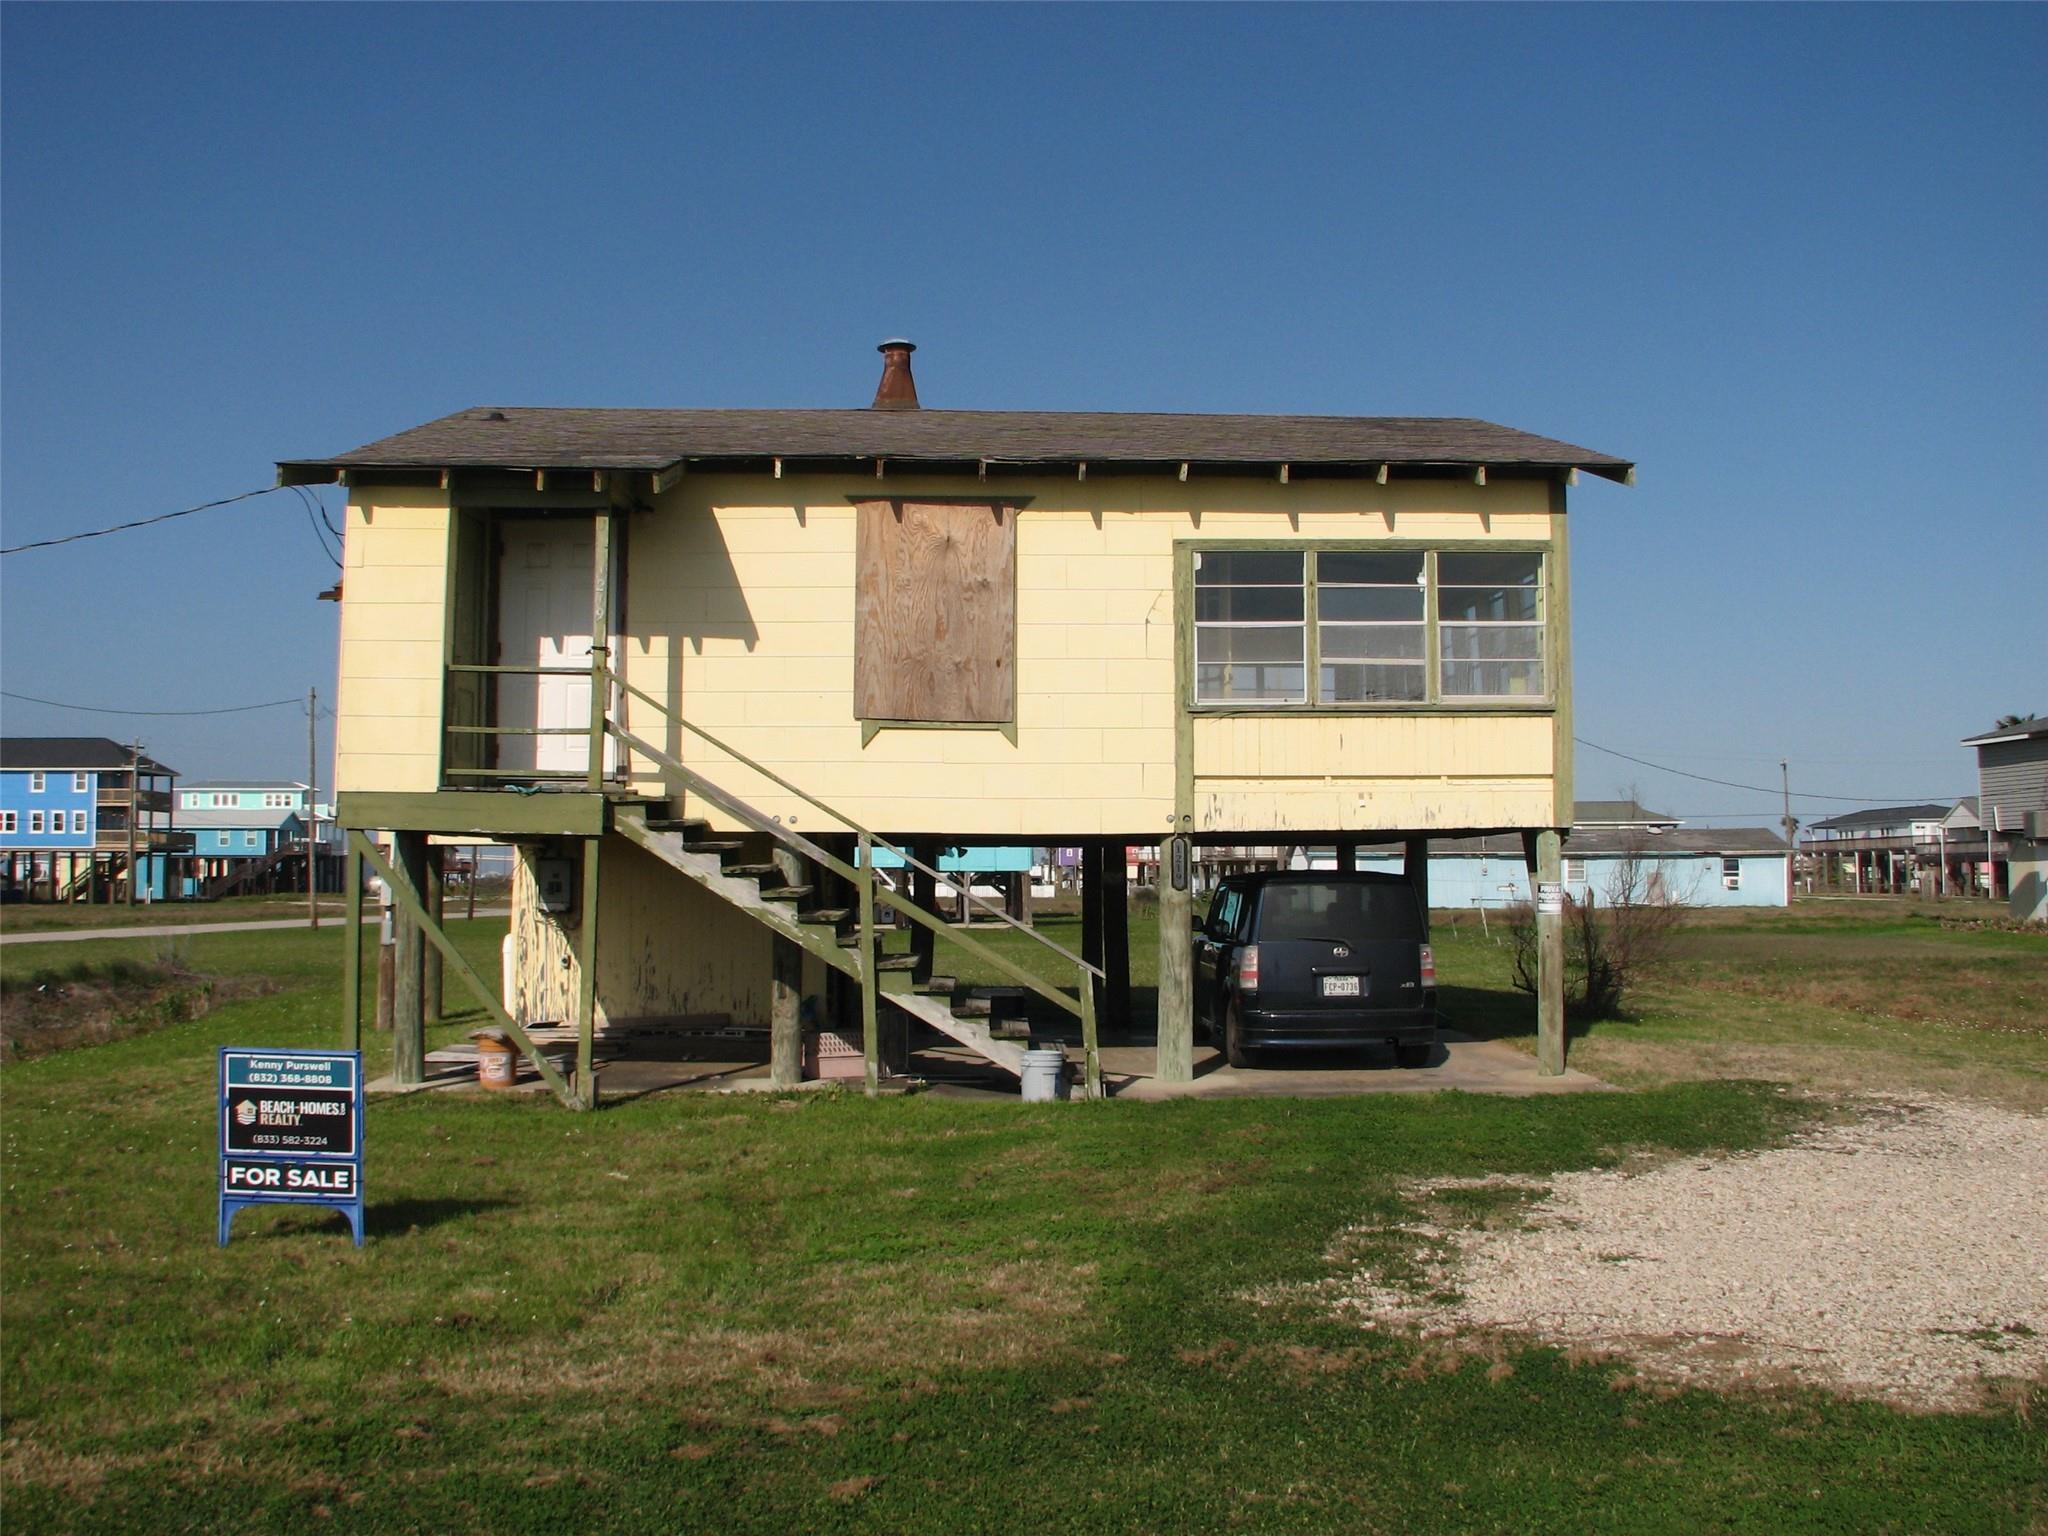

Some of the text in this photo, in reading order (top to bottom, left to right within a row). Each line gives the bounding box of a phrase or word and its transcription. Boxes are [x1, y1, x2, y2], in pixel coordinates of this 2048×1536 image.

[250, 1060, 331, 1071] Kenny Purswell
[249, 1073, 278, 1083] (832)
[260, 1113, 301, 1126] REALTY
[253, 1134, 328, 1145] (833) 582-3224
[231, 1167, 349, 1189] FOR SALE
